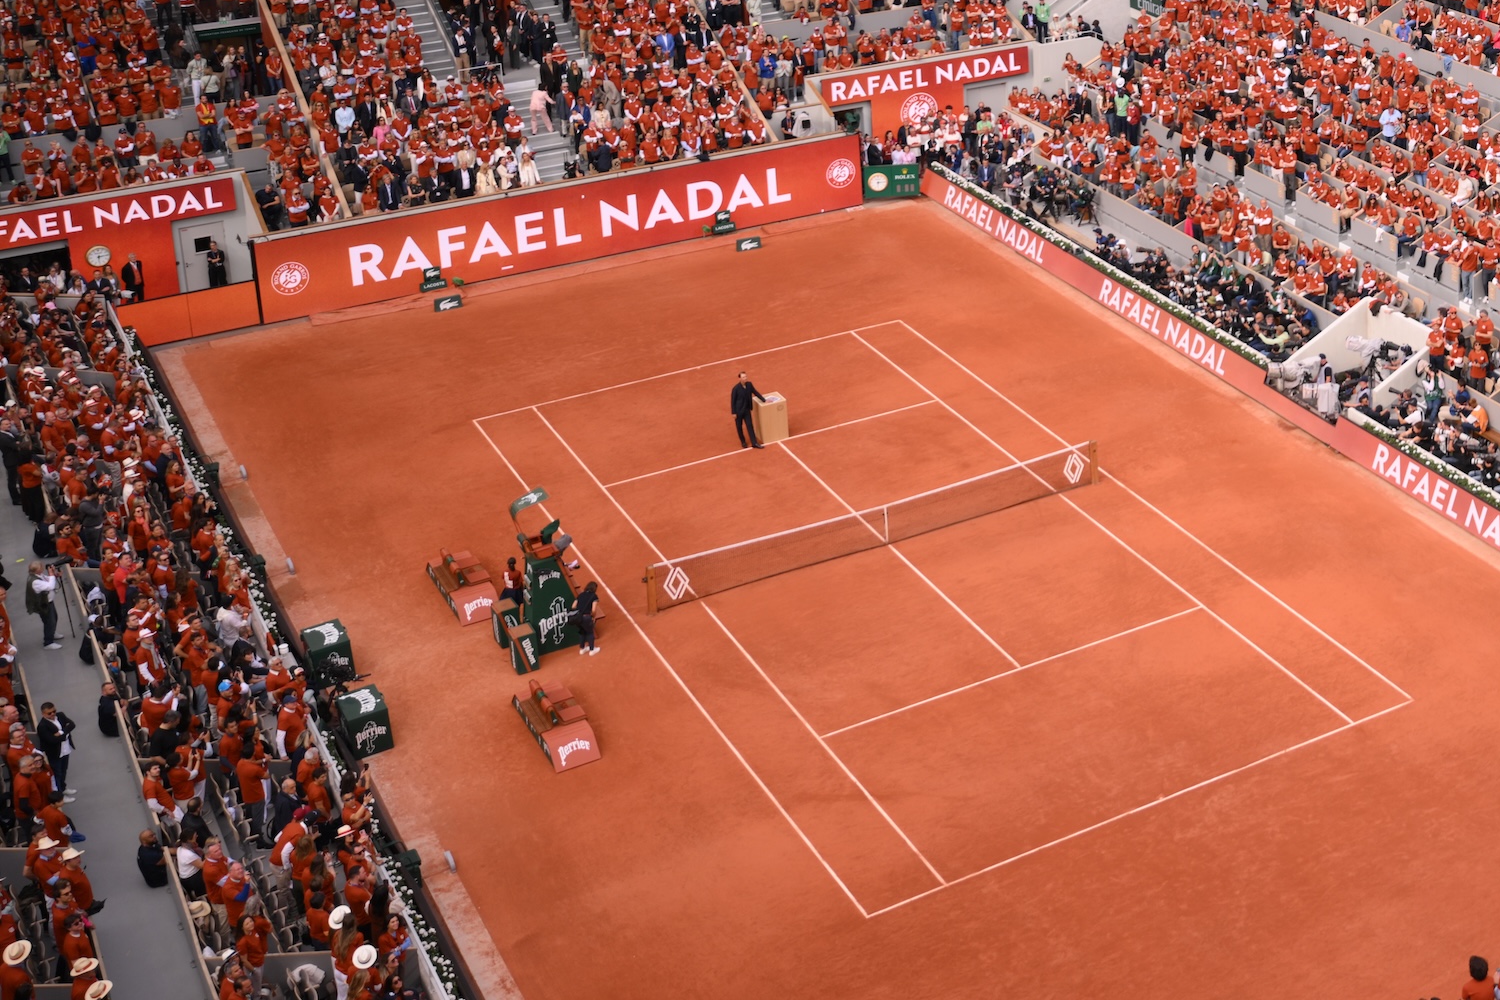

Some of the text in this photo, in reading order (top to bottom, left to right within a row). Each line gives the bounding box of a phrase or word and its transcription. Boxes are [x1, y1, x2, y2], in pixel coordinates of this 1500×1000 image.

[831, 53, 1021, 102] RAFAEL NADAL
[93, 187, 223, 228] NADAL
[349, 168, 792, 287] RAFAEL NADAL
[715, 223, 735, 231] LACOSTE
[944, 185, 1045, 264] RAFAEL NADAL
[423, 281, 445, 289] LACOSTE
[1098, 279, 1226, 376] RAFAEL NADAL
[1372, 443, 1459, 520] RAFAEL
